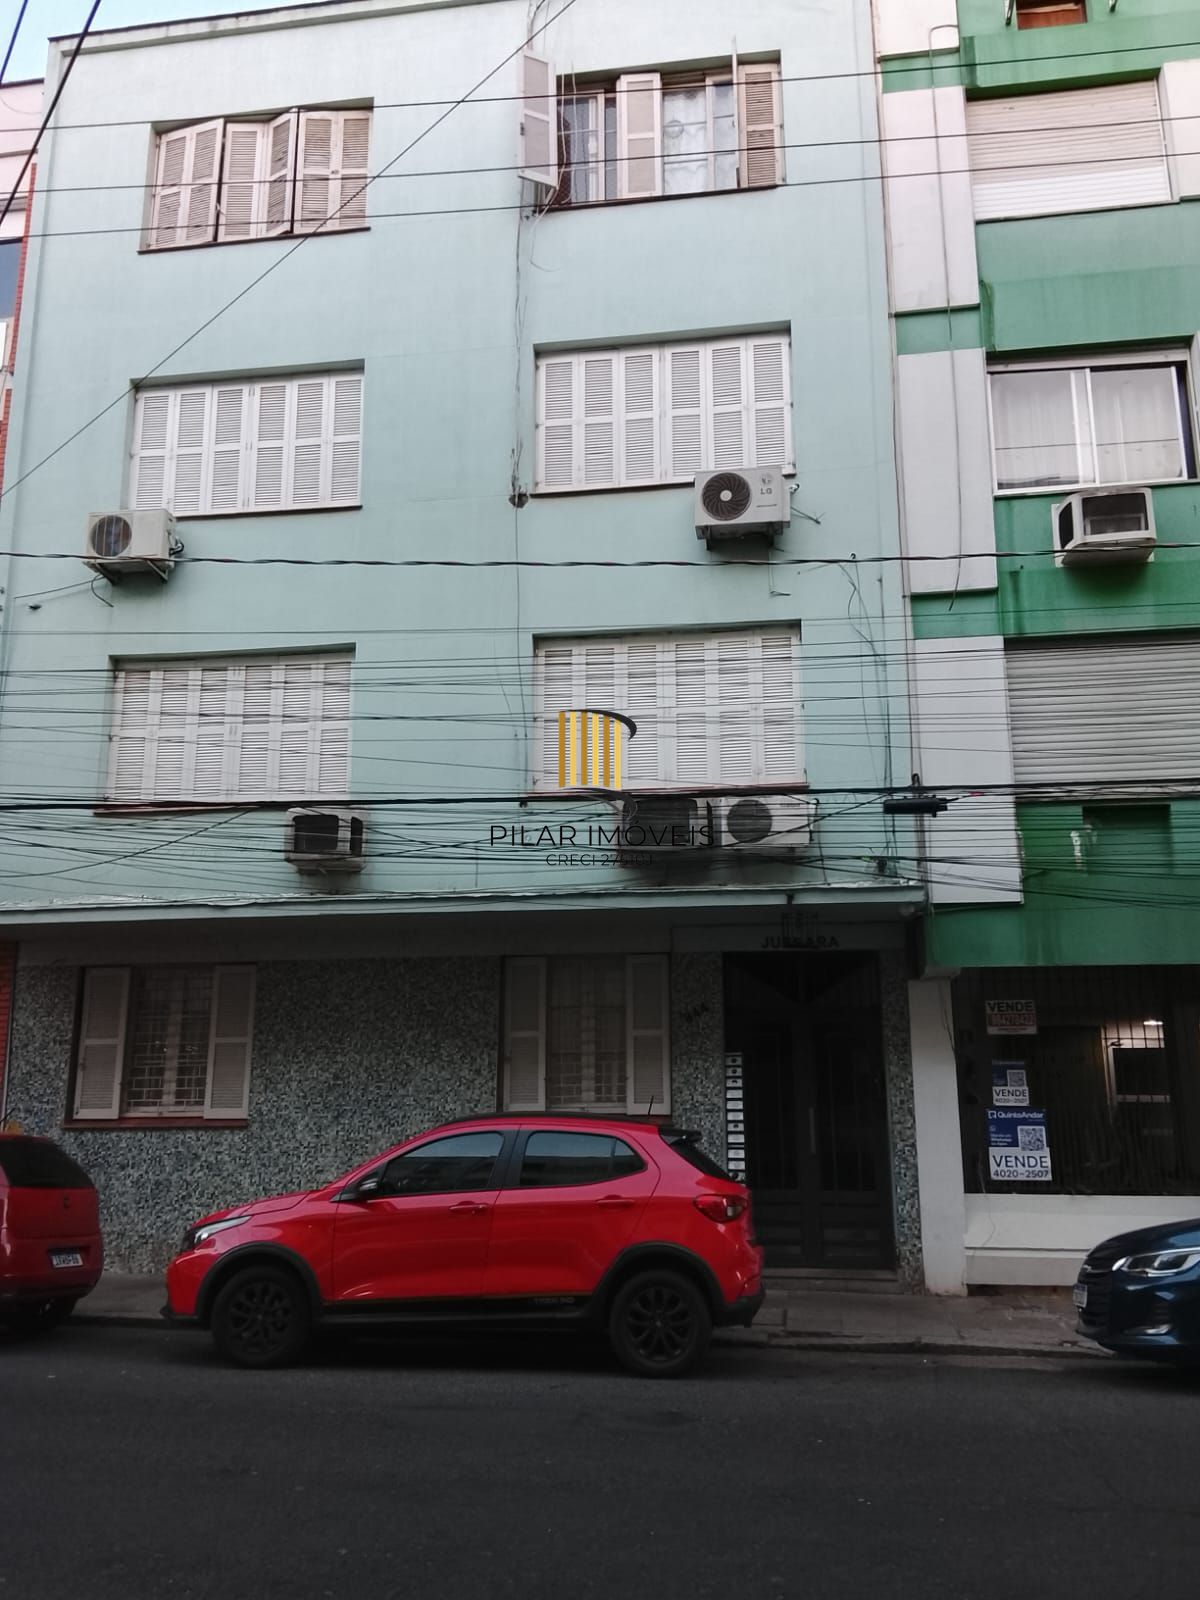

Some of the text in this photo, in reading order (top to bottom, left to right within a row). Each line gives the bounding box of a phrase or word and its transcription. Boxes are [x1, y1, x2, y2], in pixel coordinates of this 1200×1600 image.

[760, 487, 773, 495] LG
[986, 1001, 1034, 1013] VENDE
[994, 1088, 1027, 1097] VENDE
[997, 1111, 1044, 1119] QuintoAndar
[992, 1155, 1049, 1169] VENDE
[993, 1169, 1049, 1179] 4020-2507
